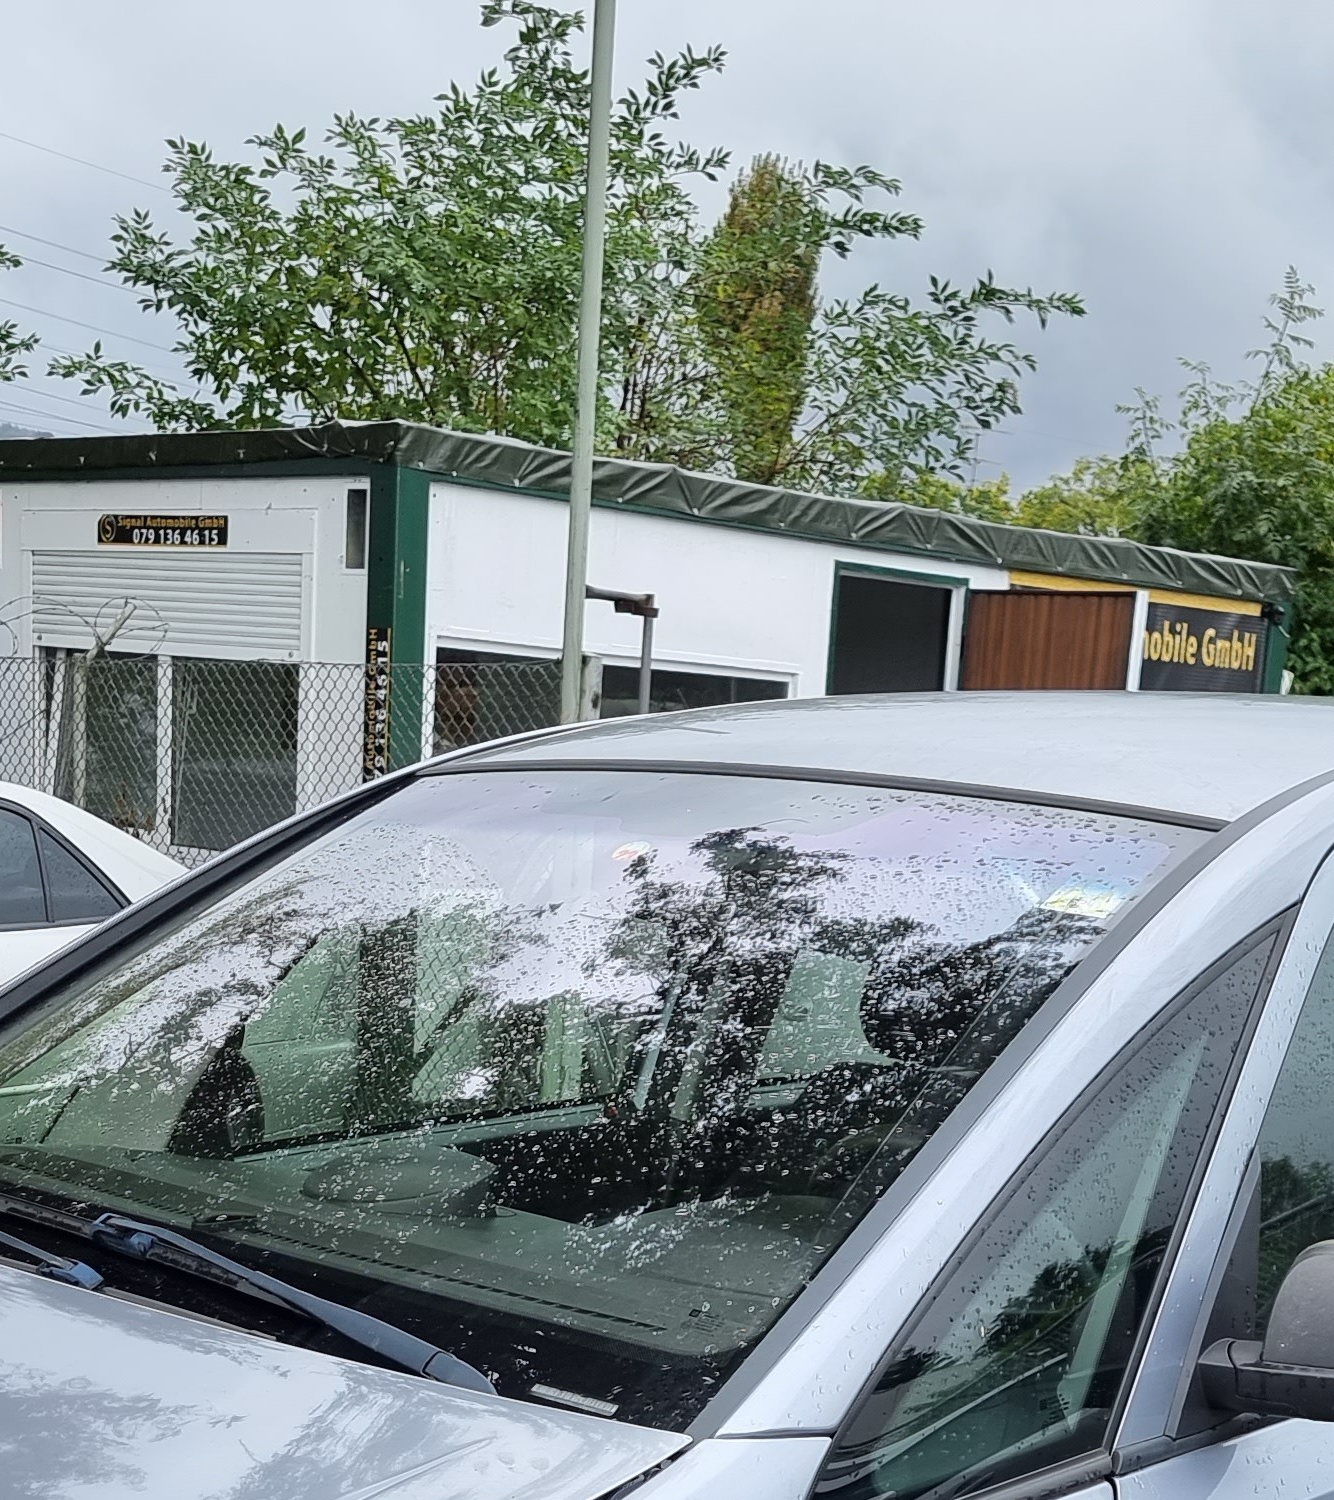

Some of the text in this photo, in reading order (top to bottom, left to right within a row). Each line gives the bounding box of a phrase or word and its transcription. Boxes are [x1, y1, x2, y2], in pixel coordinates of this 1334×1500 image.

[117, 516, 225, 529] Signal Automobile GmbH
[132, 529, 219, 545] 079 136 46 15
[377, 640, 388, 664] 15
[1201, 627, 1258, 672] GmbH
